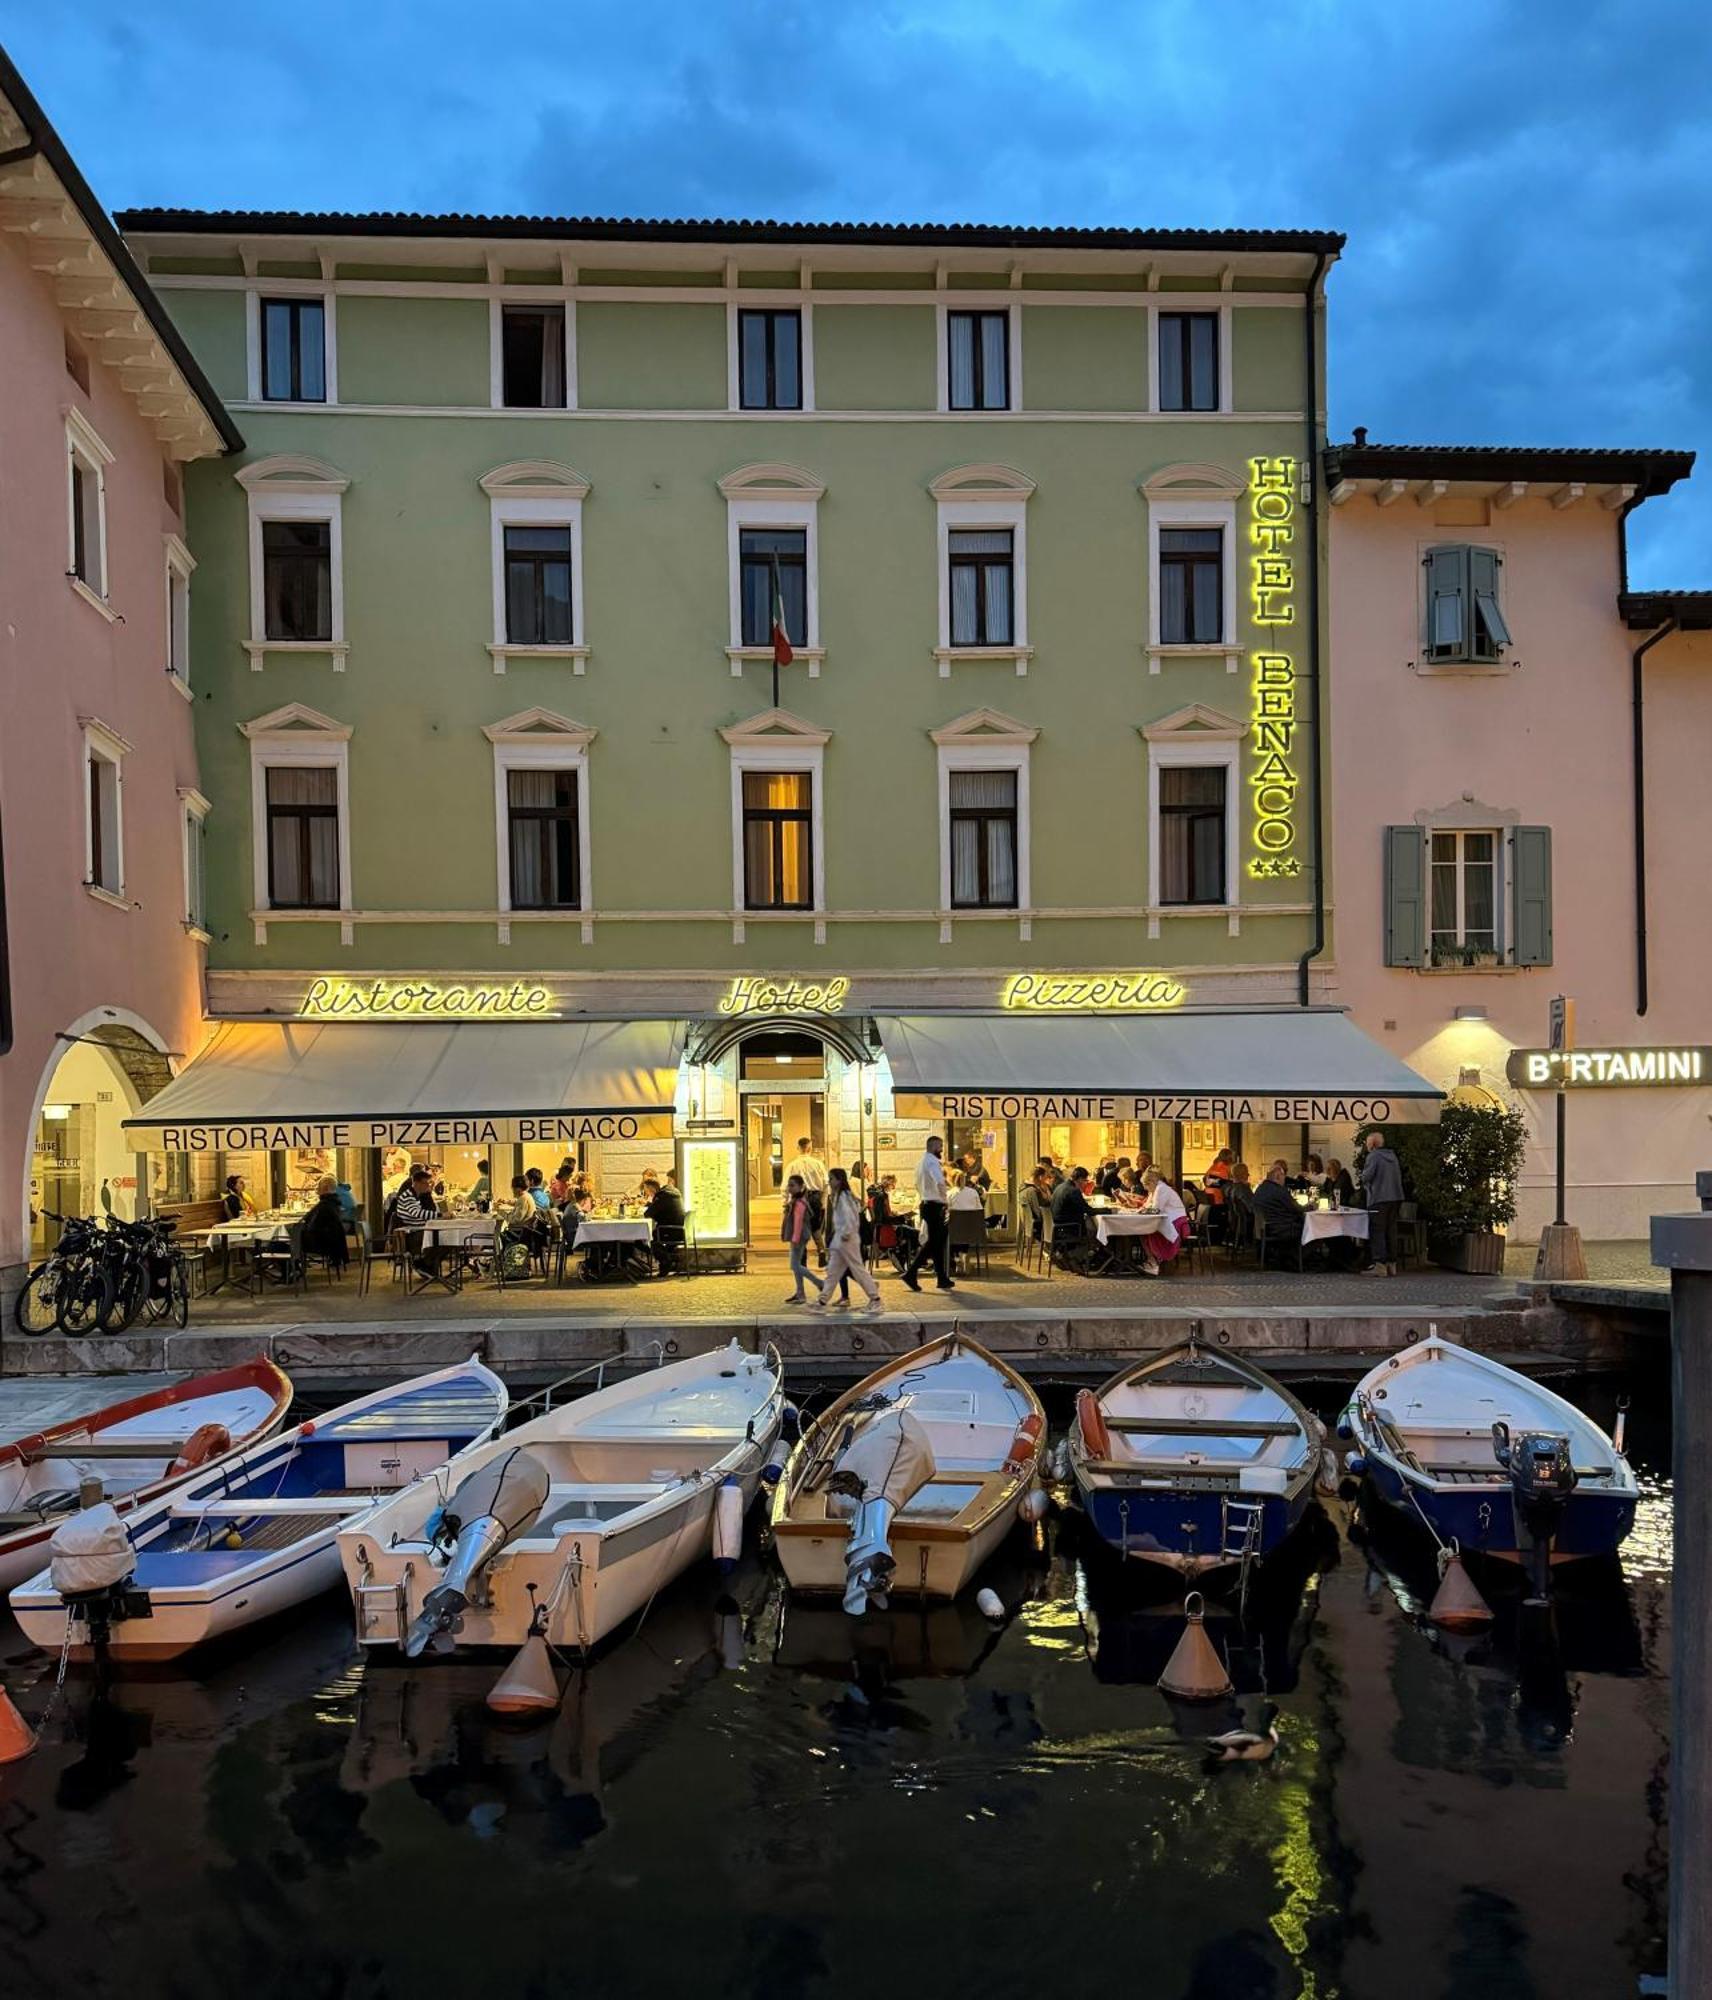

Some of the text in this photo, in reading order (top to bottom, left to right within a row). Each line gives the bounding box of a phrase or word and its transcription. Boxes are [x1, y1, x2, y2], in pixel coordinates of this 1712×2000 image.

[1253, 458, 1297, 850] HOTEL BENACO
[300, 978, 548, 1015] Ristorante
[721, 978, 846, 1012] Hotel
[1007, 975, 1183, 1007] Pizzeria
[942, 1096, 1391, 1122] RISTORANTE PIZZERIA BENACO
[162, 1116, 639, 1151] RISTORANTE PIZZERIA BENACO
